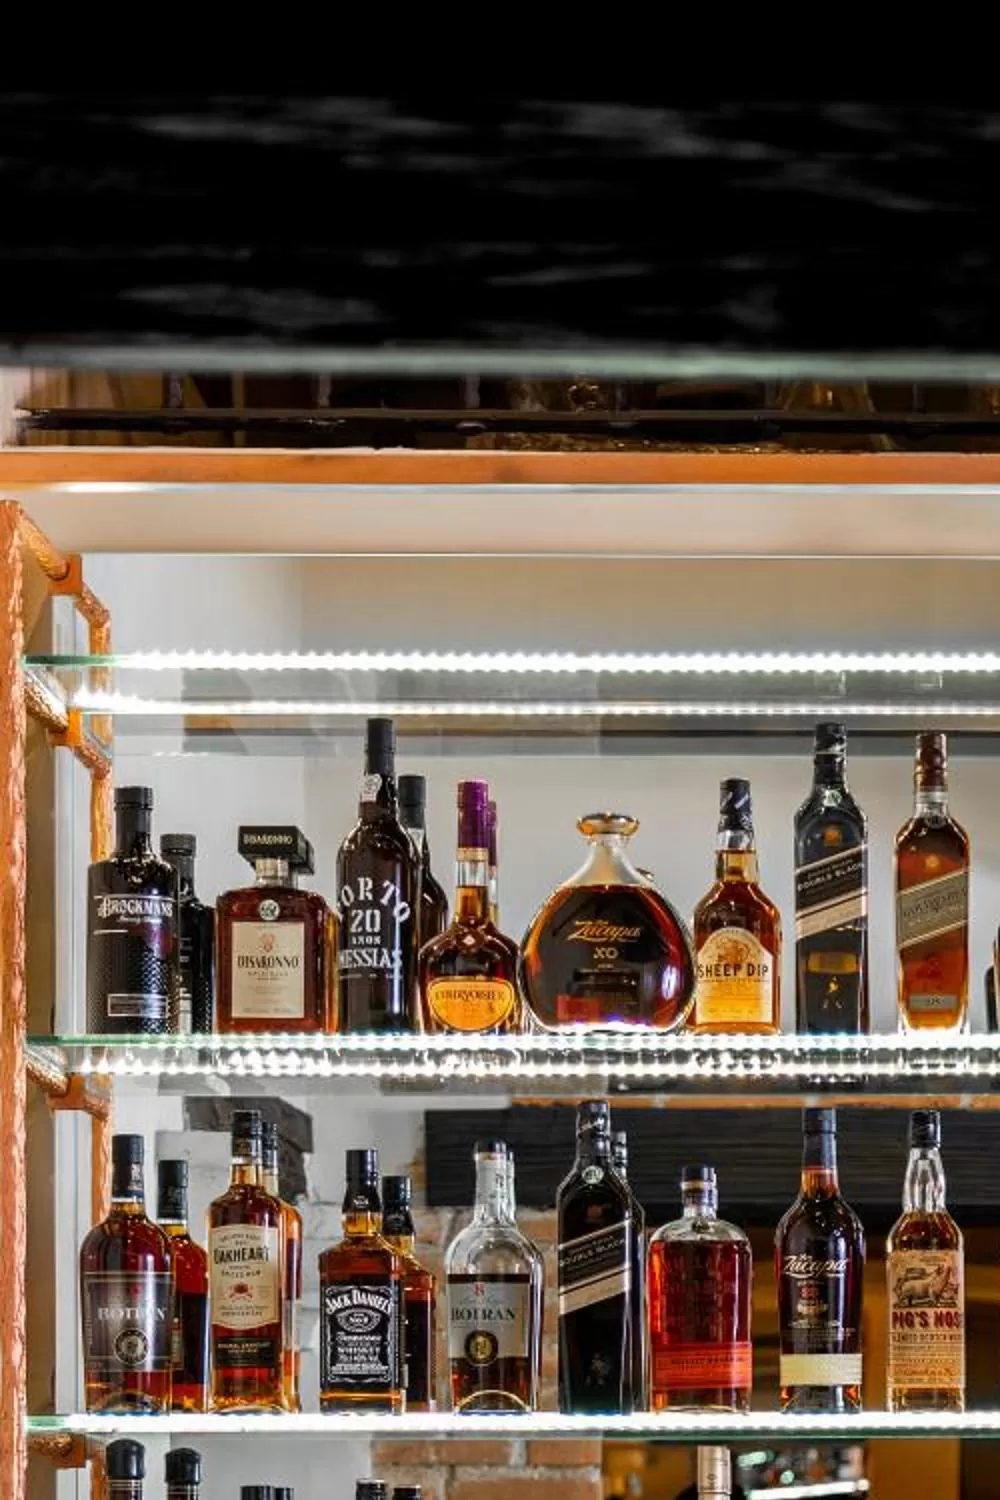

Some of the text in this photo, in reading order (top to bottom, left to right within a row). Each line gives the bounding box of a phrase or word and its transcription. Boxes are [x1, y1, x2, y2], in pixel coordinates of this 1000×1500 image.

[97, 898, 173, 918] BROCKMANS
[350, 909, 382, 933] 20
[593, 947, 618, 960] XO
[237, 955, 299, 970] DISARONNO
[697, 963, 768, 979] SHEEP DIP
[326, 1292, 350, 1315] JACK
[98, 1306, 166, 1321] BOTN
[892, 1311, 961, 1329] PIG'S NOS
